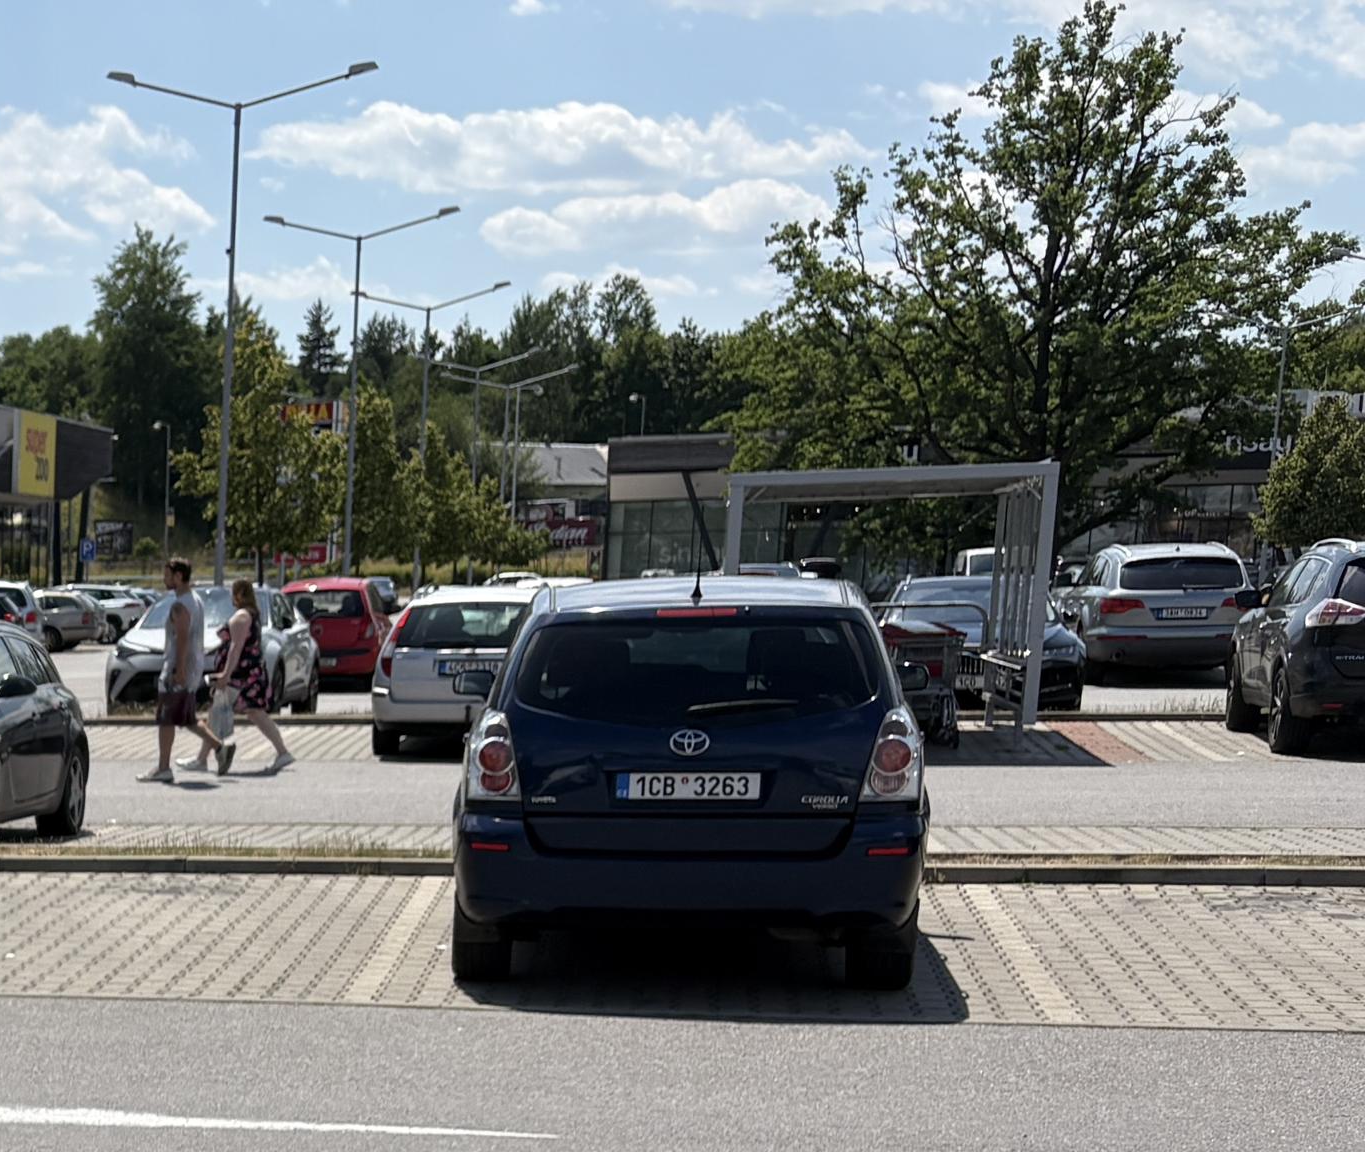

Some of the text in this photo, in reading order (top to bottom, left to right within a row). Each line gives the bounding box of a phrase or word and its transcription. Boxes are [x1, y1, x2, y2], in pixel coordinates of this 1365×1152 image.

[83, 541, 93, 556] P
[636, 776, 675, 797] 1CB
[693, 776, 749, 797] 3263
